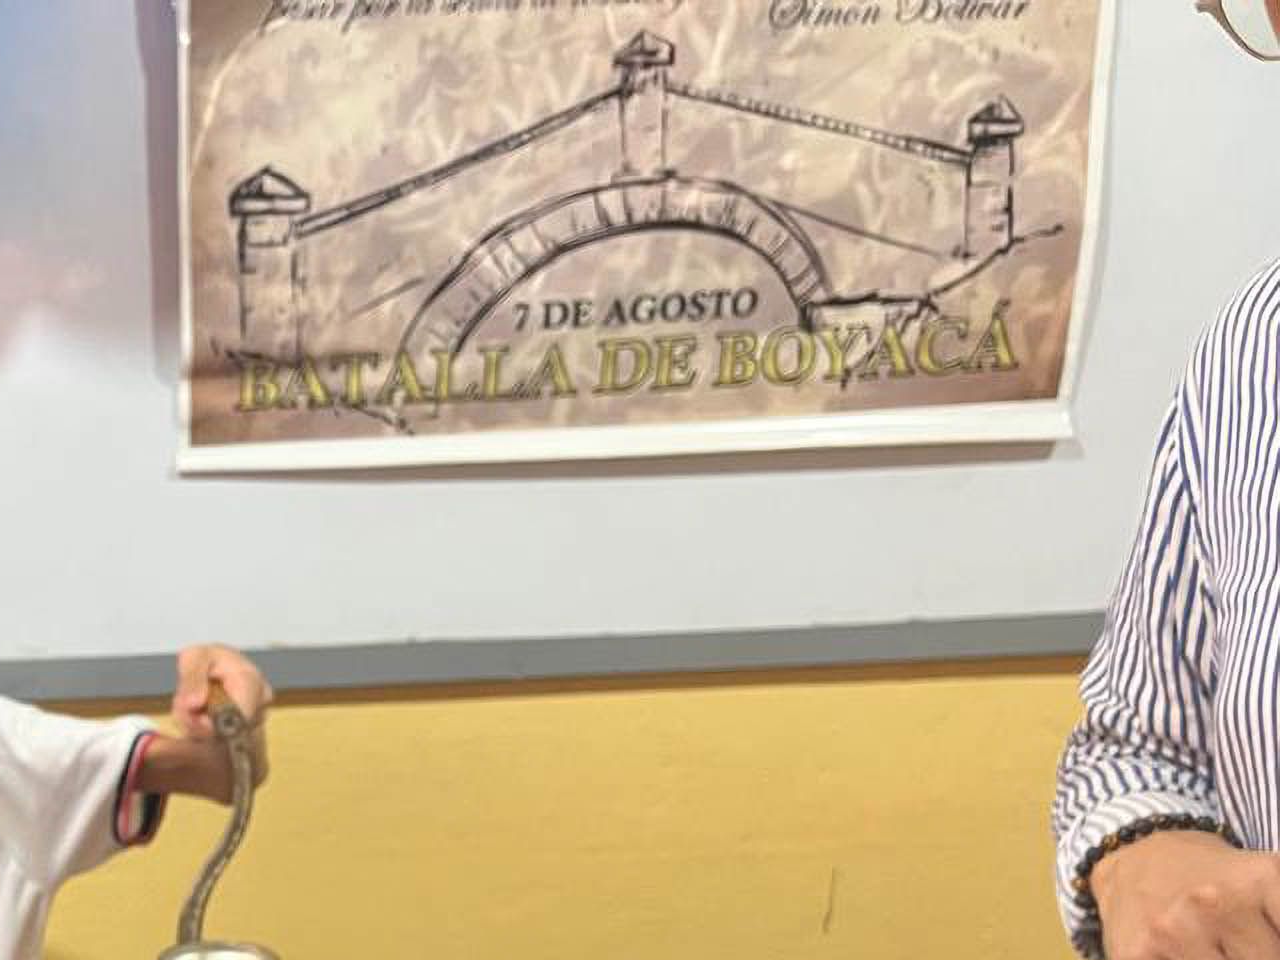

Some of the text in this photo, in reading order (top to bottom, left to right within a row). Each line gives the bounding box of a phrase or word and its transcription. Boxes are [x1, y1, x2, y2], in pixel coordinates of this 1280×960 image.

[513, 286, 758, 331] 7 DE AGOSTO
[239, 300, 1020, 412] BATALLA DE BOYACÁ
